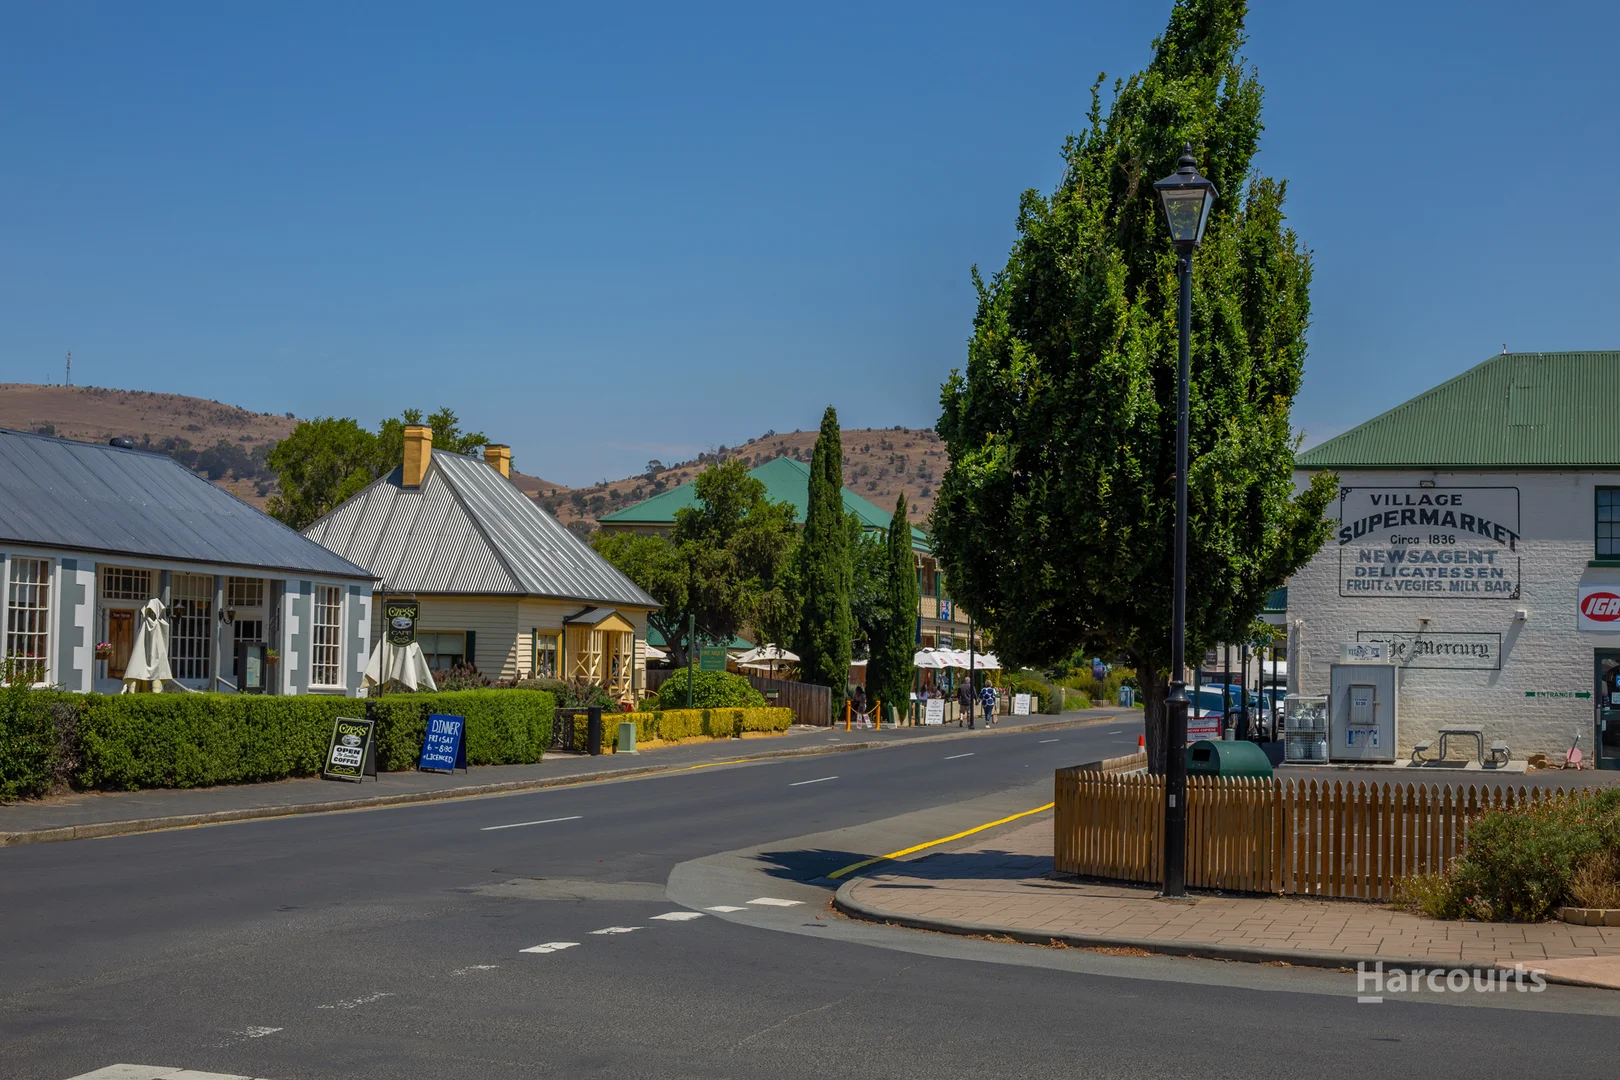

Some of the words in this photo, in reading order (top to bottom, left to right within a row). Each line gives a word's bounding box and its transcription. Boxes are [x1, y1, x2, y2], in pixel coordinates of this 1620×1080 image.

[1370, 494, 1463, 506] VILLAGE
[1339, 508, 1520, 553] SUPERMARKET
[1390, 534, 1419, 544] Circa
[1429, 534, 1456, 544] 1836
[1359, 549, 1498, 564] NEWSAGENT
[1355, 566, 1504, 579] DELICATESSEN
[1347, 579, 1384, 591] FRUIT
[1449, 581, 1480, 593] MILK
[1484, 581, 1512, 593] BAR
[1585, 597, 1620, 615] IGA
[1413, 640, 1490, 659] Mercury
[432, 719, 460, 736] DINNER
[441, 736, 454, 744] SAT
[336, 747, 360, 755] OPEN
[333, 757, 359, 765] COFFEE
